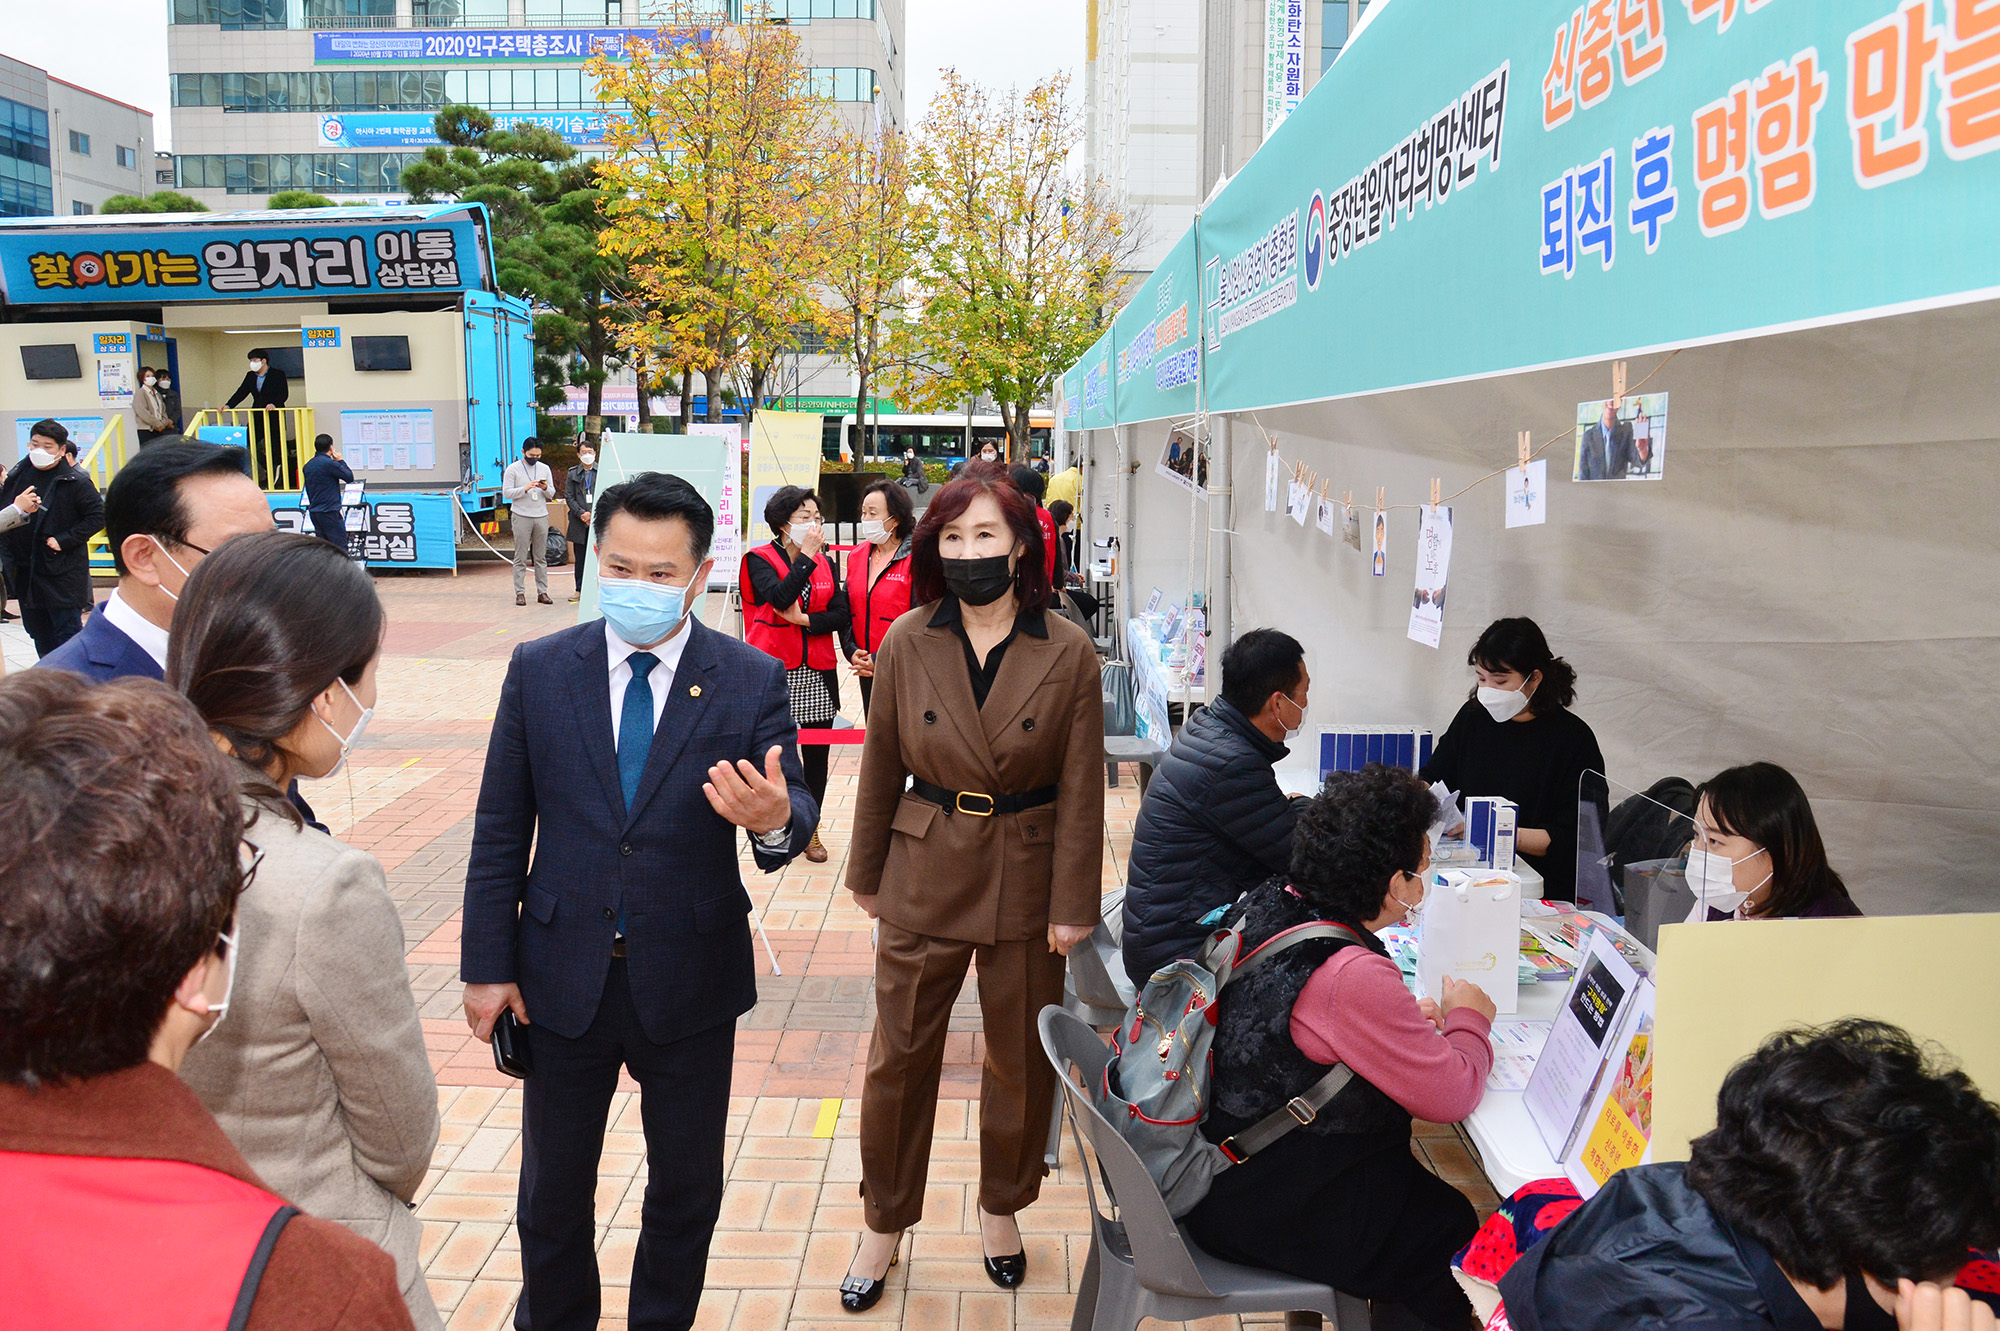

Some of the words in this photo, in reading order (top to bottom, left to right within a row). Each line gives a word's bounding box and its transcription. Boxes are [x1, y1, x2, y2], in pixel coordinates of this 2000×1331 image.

[1287, 0, 1302, 48] 화탄소
[1276, 40, 1286, 59] 규제
[1543, 0, 1664, 126] 신중년
[1286, 52, 1301, 96] 자원화
[1541, 153, 1615, 274] 퇴직
[1631, 134, 1675, 248] 후
[1695, 57, 1824, 230] 명함
[204, 238, 370, 290] 일자리
[377, 231, 455, 261] 이동
[378, 261, 460, 287] 상담실
[99, 335, 126, 345] 일자리
[307, 329, 336, 339] 일자리
[1605, 1107, 1622, 1135] 타로를
[1619, 1128, 1640, 1158] 이용한
[1604, 1138, 1622, 1165] 신중년
